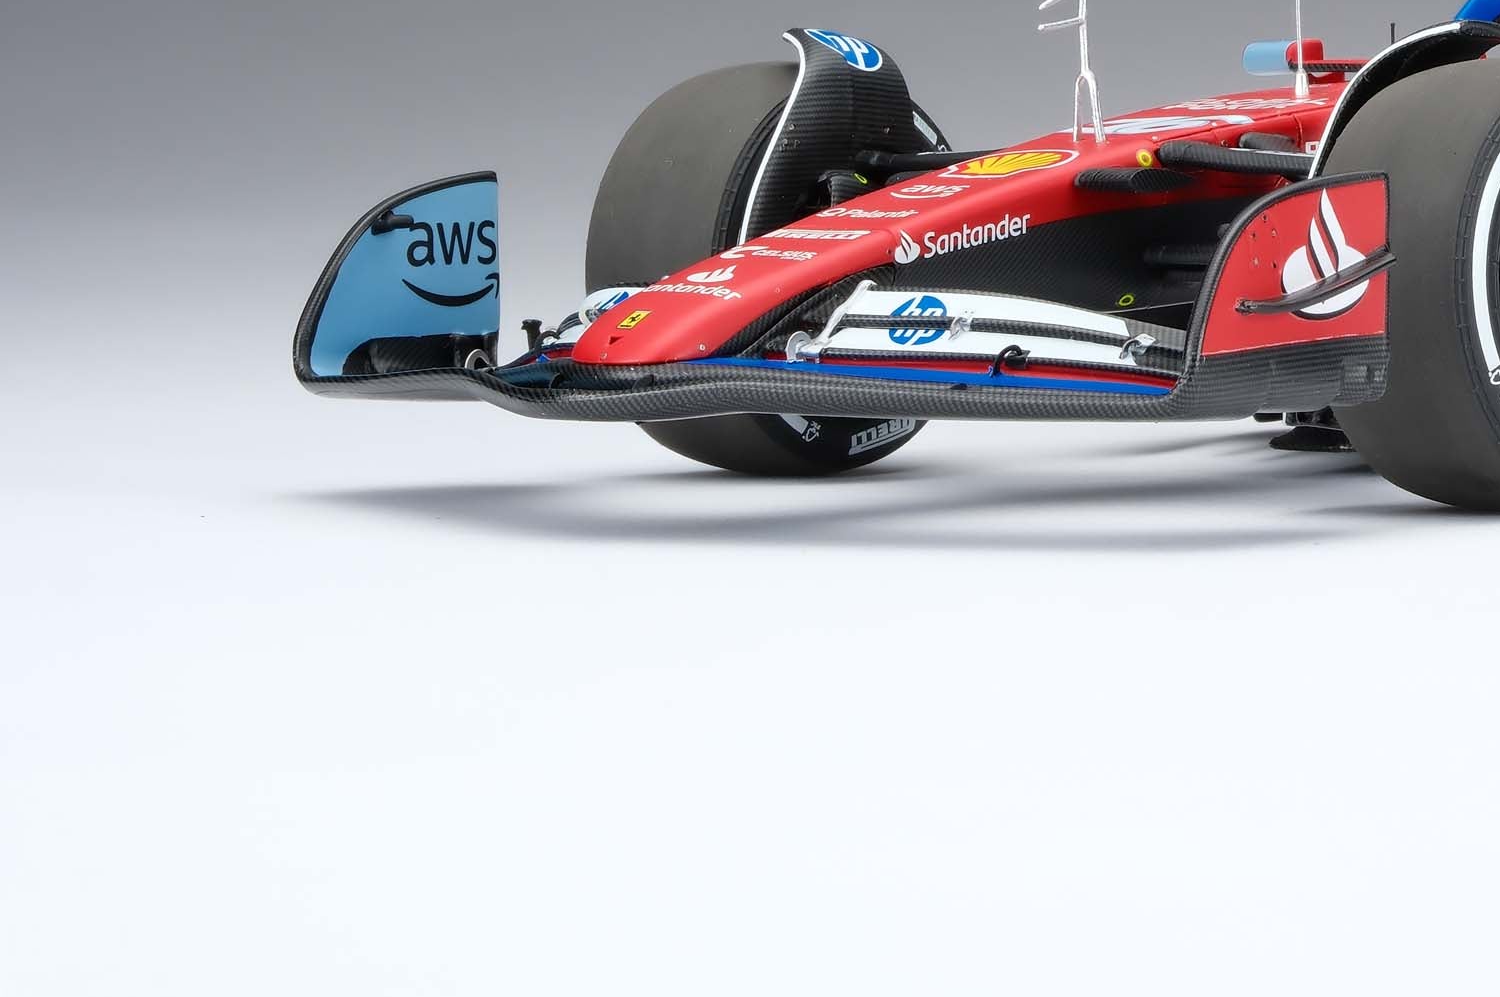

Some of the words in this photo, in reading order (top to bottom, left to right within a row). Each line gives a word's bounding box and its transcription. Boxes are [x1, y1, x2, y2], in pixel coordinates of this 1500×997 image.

[805, 29, 871, 68] hp
[407, 220, 497, 267] aws
[923, 213, 1031, 259] Santander
[641, 282, 742, 301] antander
[892, 295, 945, 346] hp
